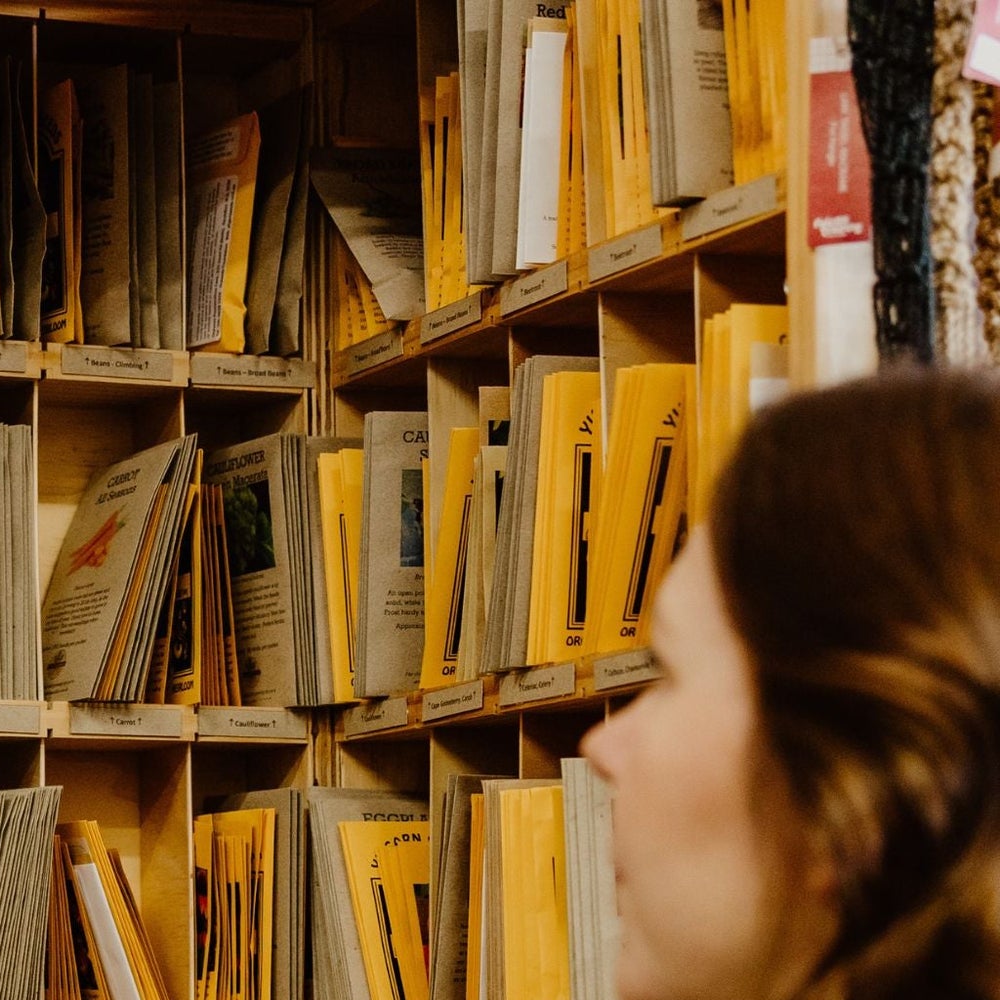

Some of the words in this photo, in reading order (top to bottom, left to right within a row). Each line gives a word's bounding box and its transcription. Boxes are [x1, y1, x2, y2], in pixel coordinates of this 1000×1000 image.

[91, 360, 111, 368] Beans
[115, 360, 143, 370] Climbing
[116, 717, 137, 725] Carrot
[235, 719, 271, 728] Cauliflower
